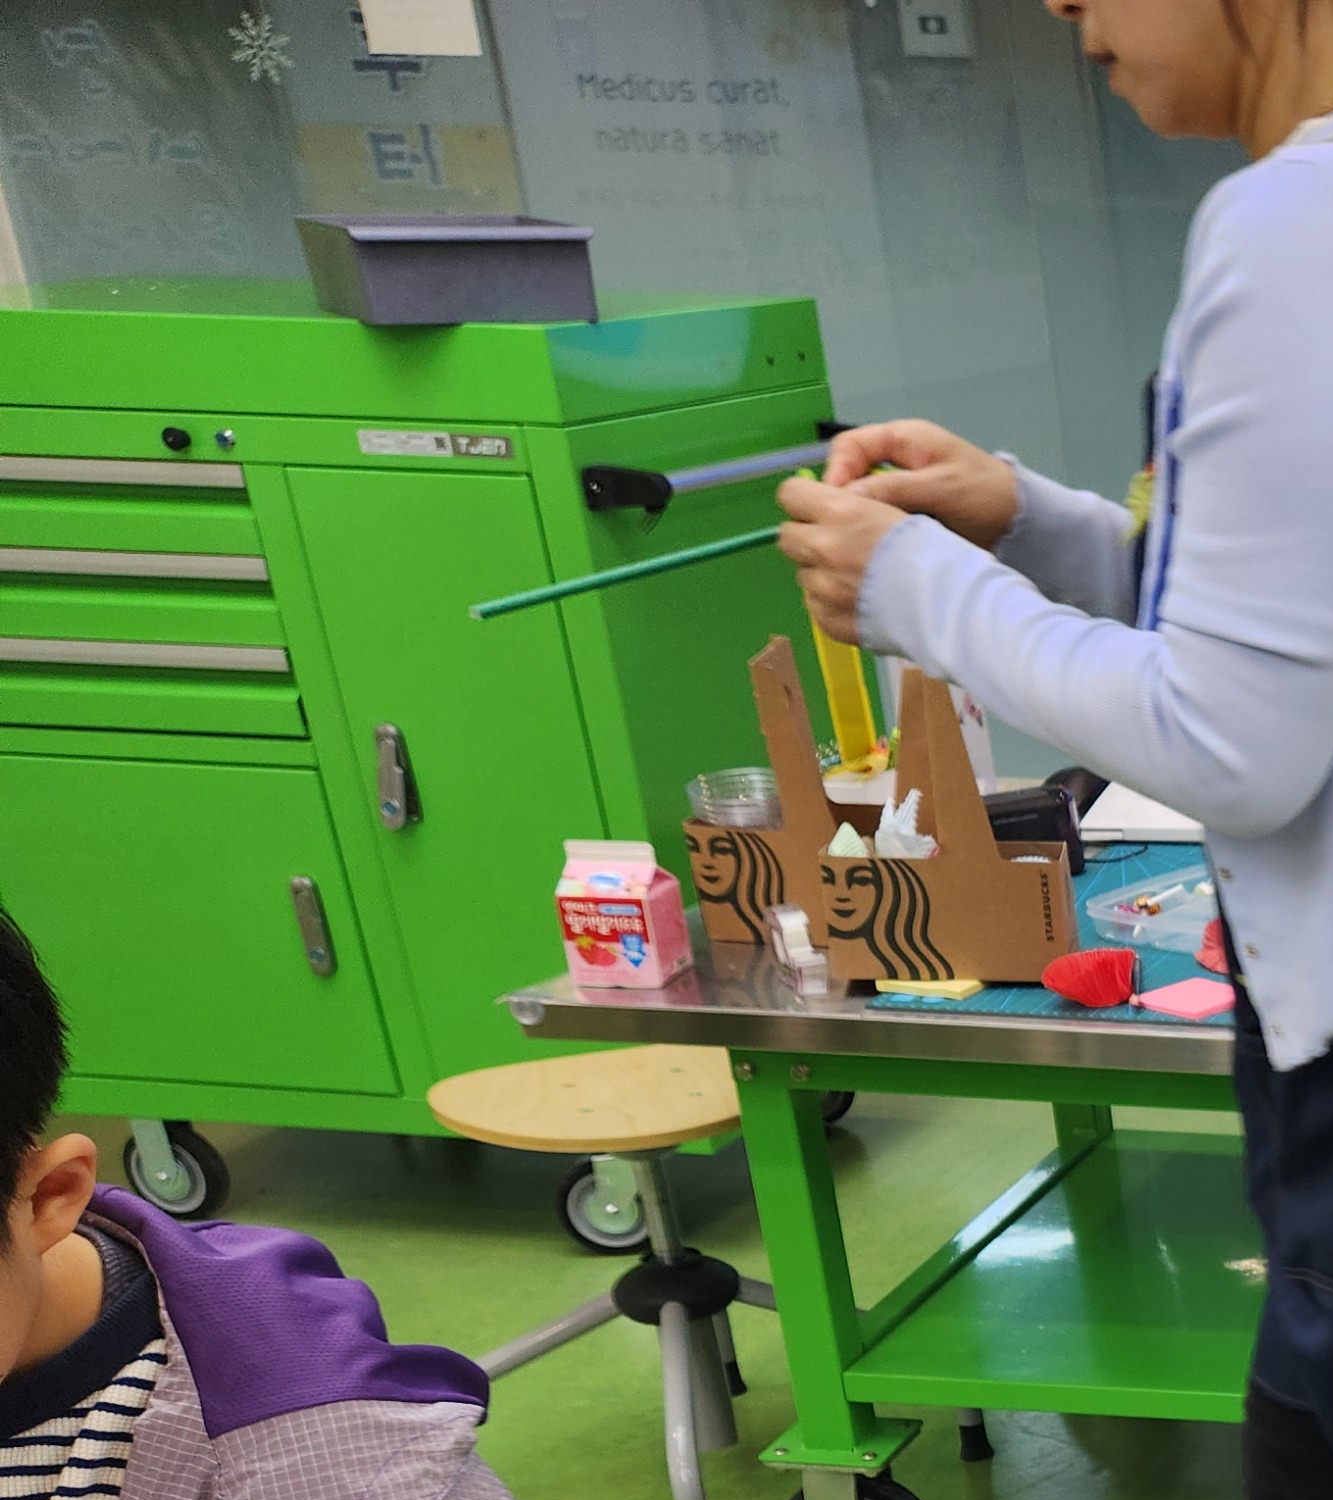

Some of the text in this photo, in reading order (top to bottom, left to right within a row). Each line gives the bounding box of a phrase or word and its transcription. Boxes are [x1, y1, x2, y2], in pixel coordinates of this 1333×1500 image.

[577, 73, 697, 102] Medicus
[598, 126, 688, 153] natura
[1040, 873, 1054, 942] STARBUCKS
